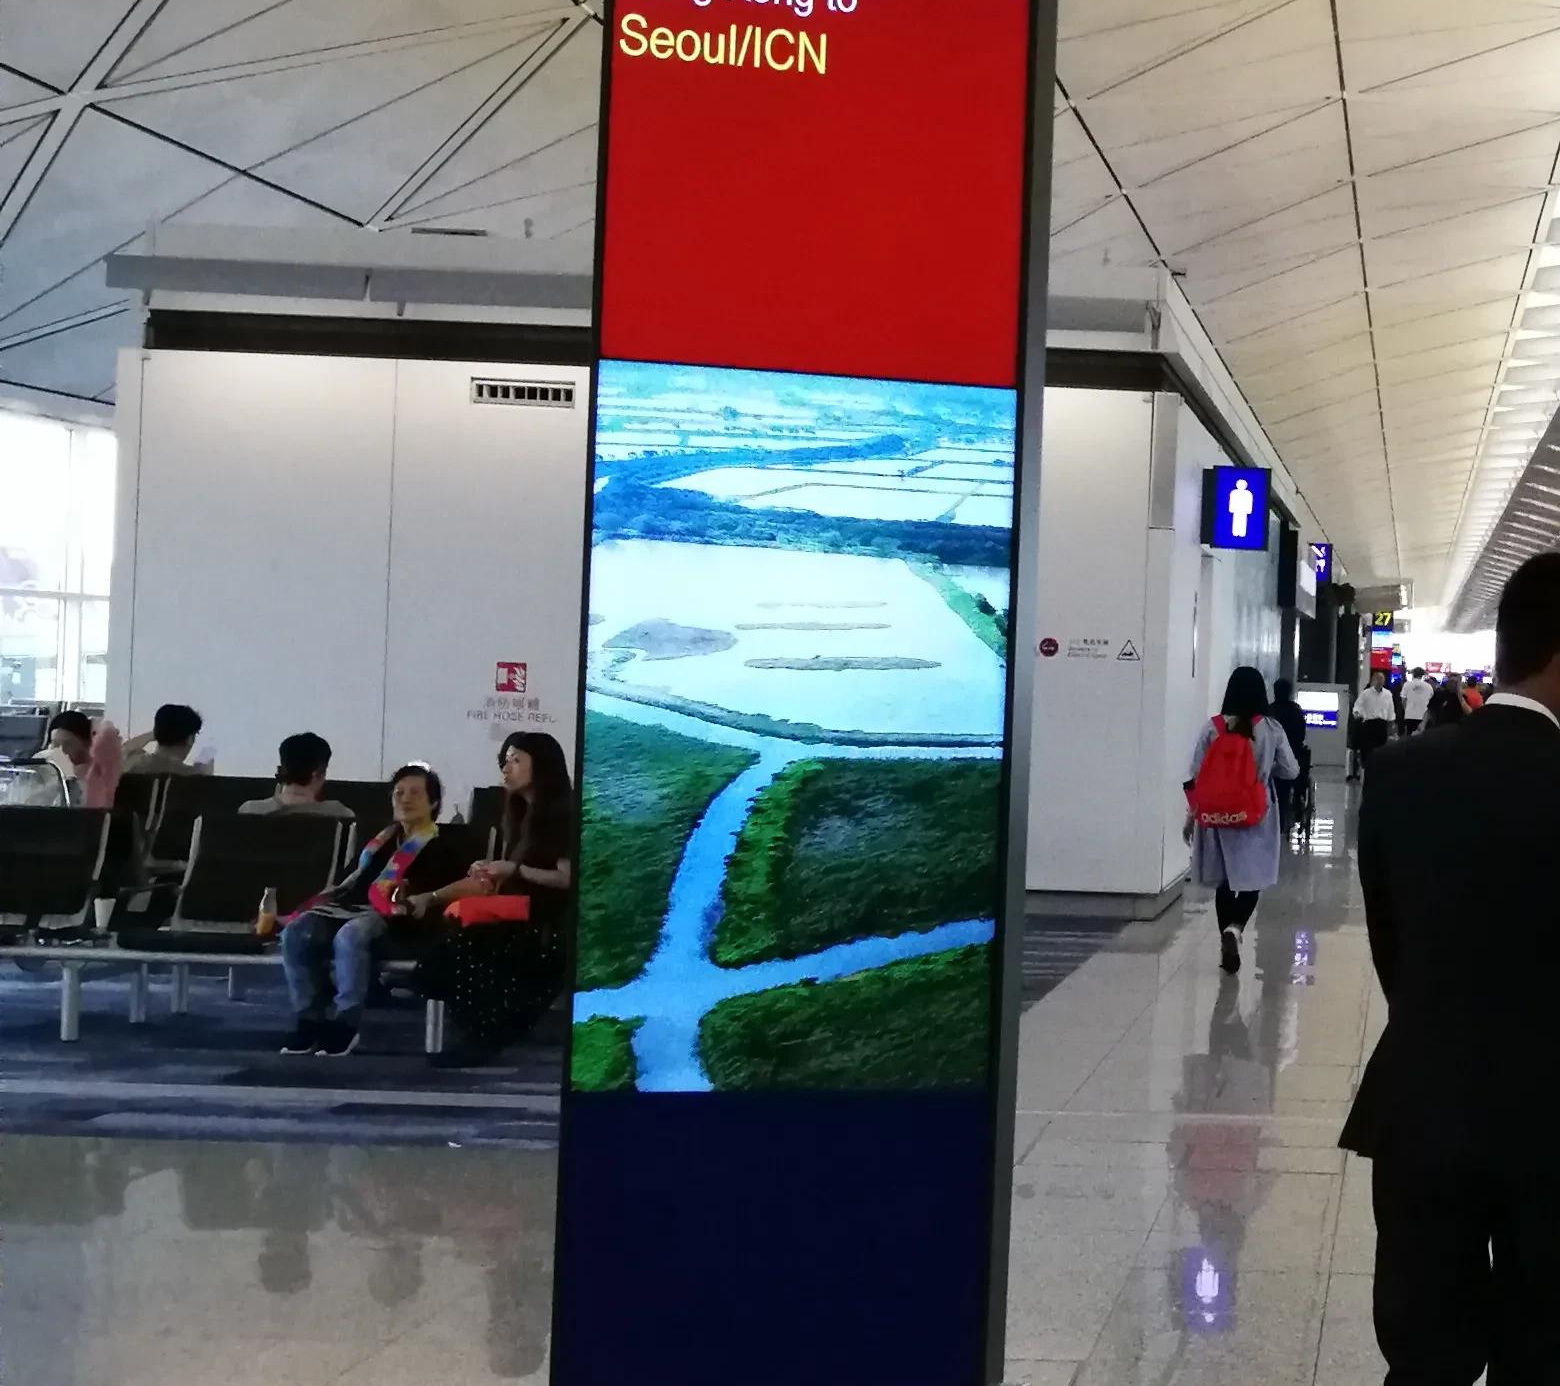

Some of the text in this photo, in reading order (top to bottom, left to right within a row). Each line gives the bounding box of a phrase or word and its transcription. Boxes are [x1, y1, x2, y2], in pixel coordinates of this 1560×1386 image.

[620, 16, 828, 75] Seoul/ICN
[1375, 612, 1391, 626] 27
[1201, 811, 1247, 825] adidas
